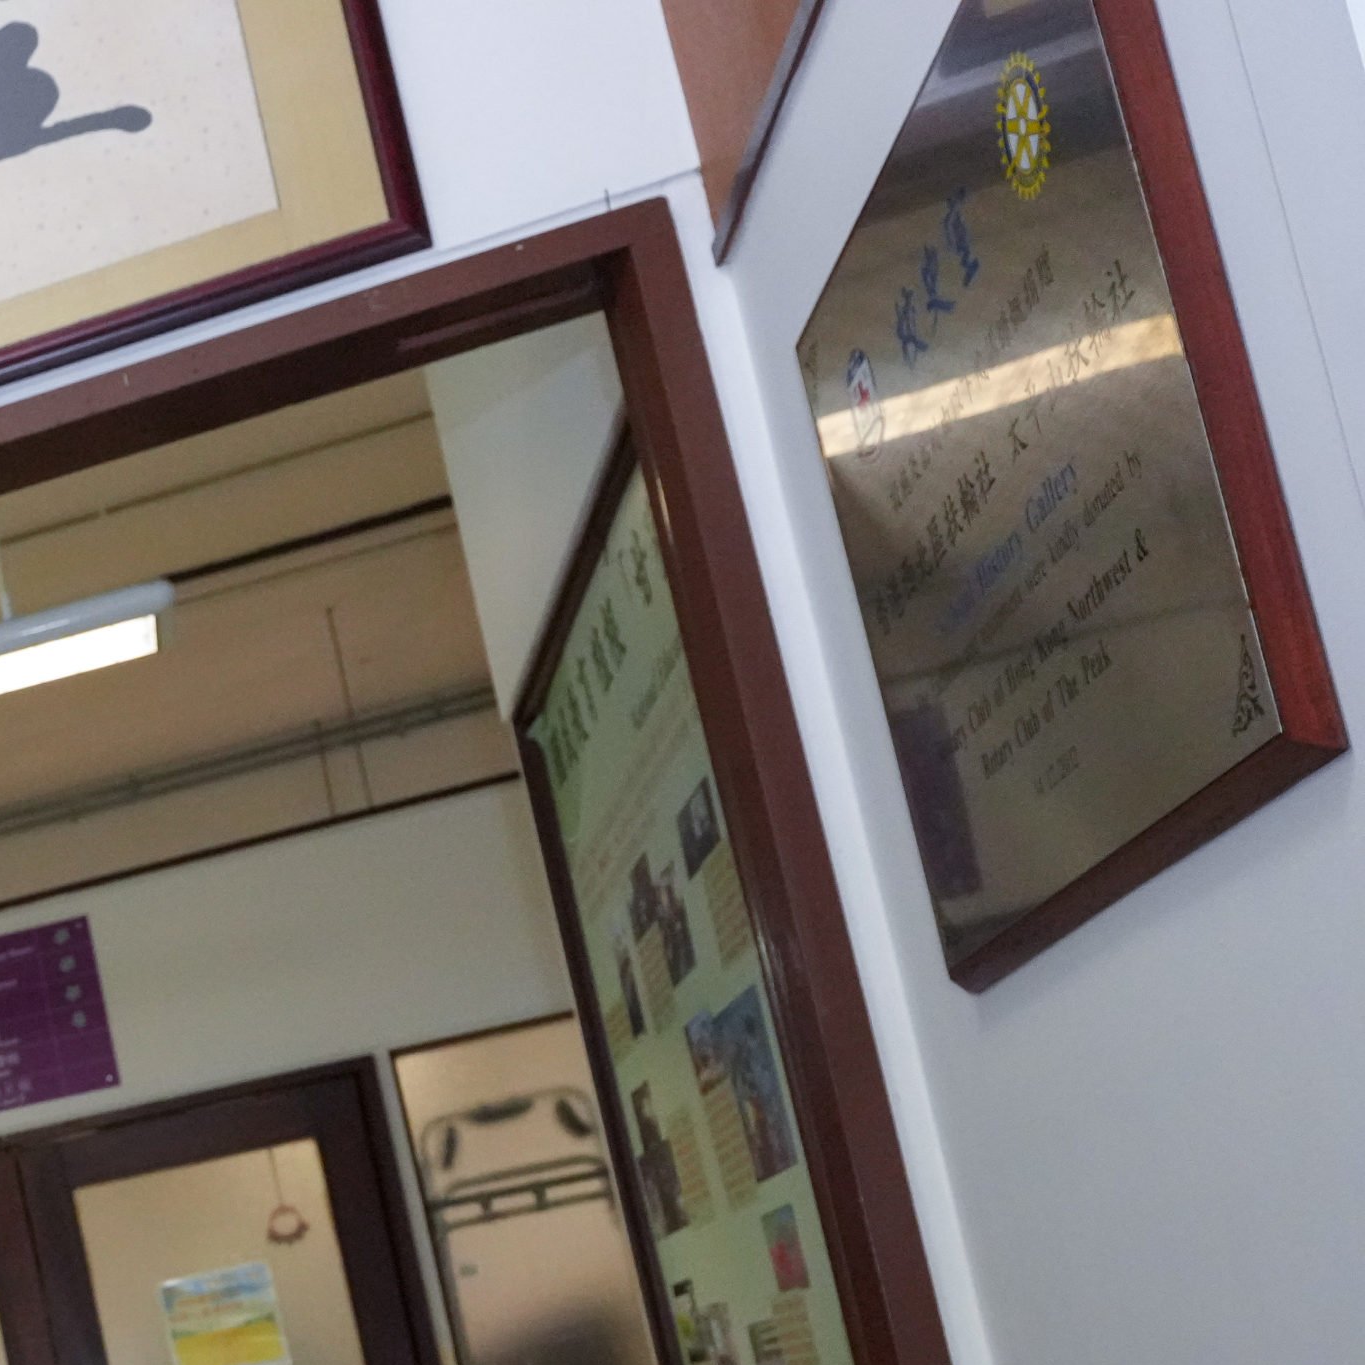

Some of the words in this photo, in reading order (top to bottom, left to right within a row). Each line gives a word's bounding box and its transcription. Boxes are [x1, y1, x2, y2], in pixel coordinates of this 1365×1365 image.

[1067, 546, 1134, 631] Northwest
[1133, 528, 1150, 564] &
[1080, 634, 1112, 687] Peak
